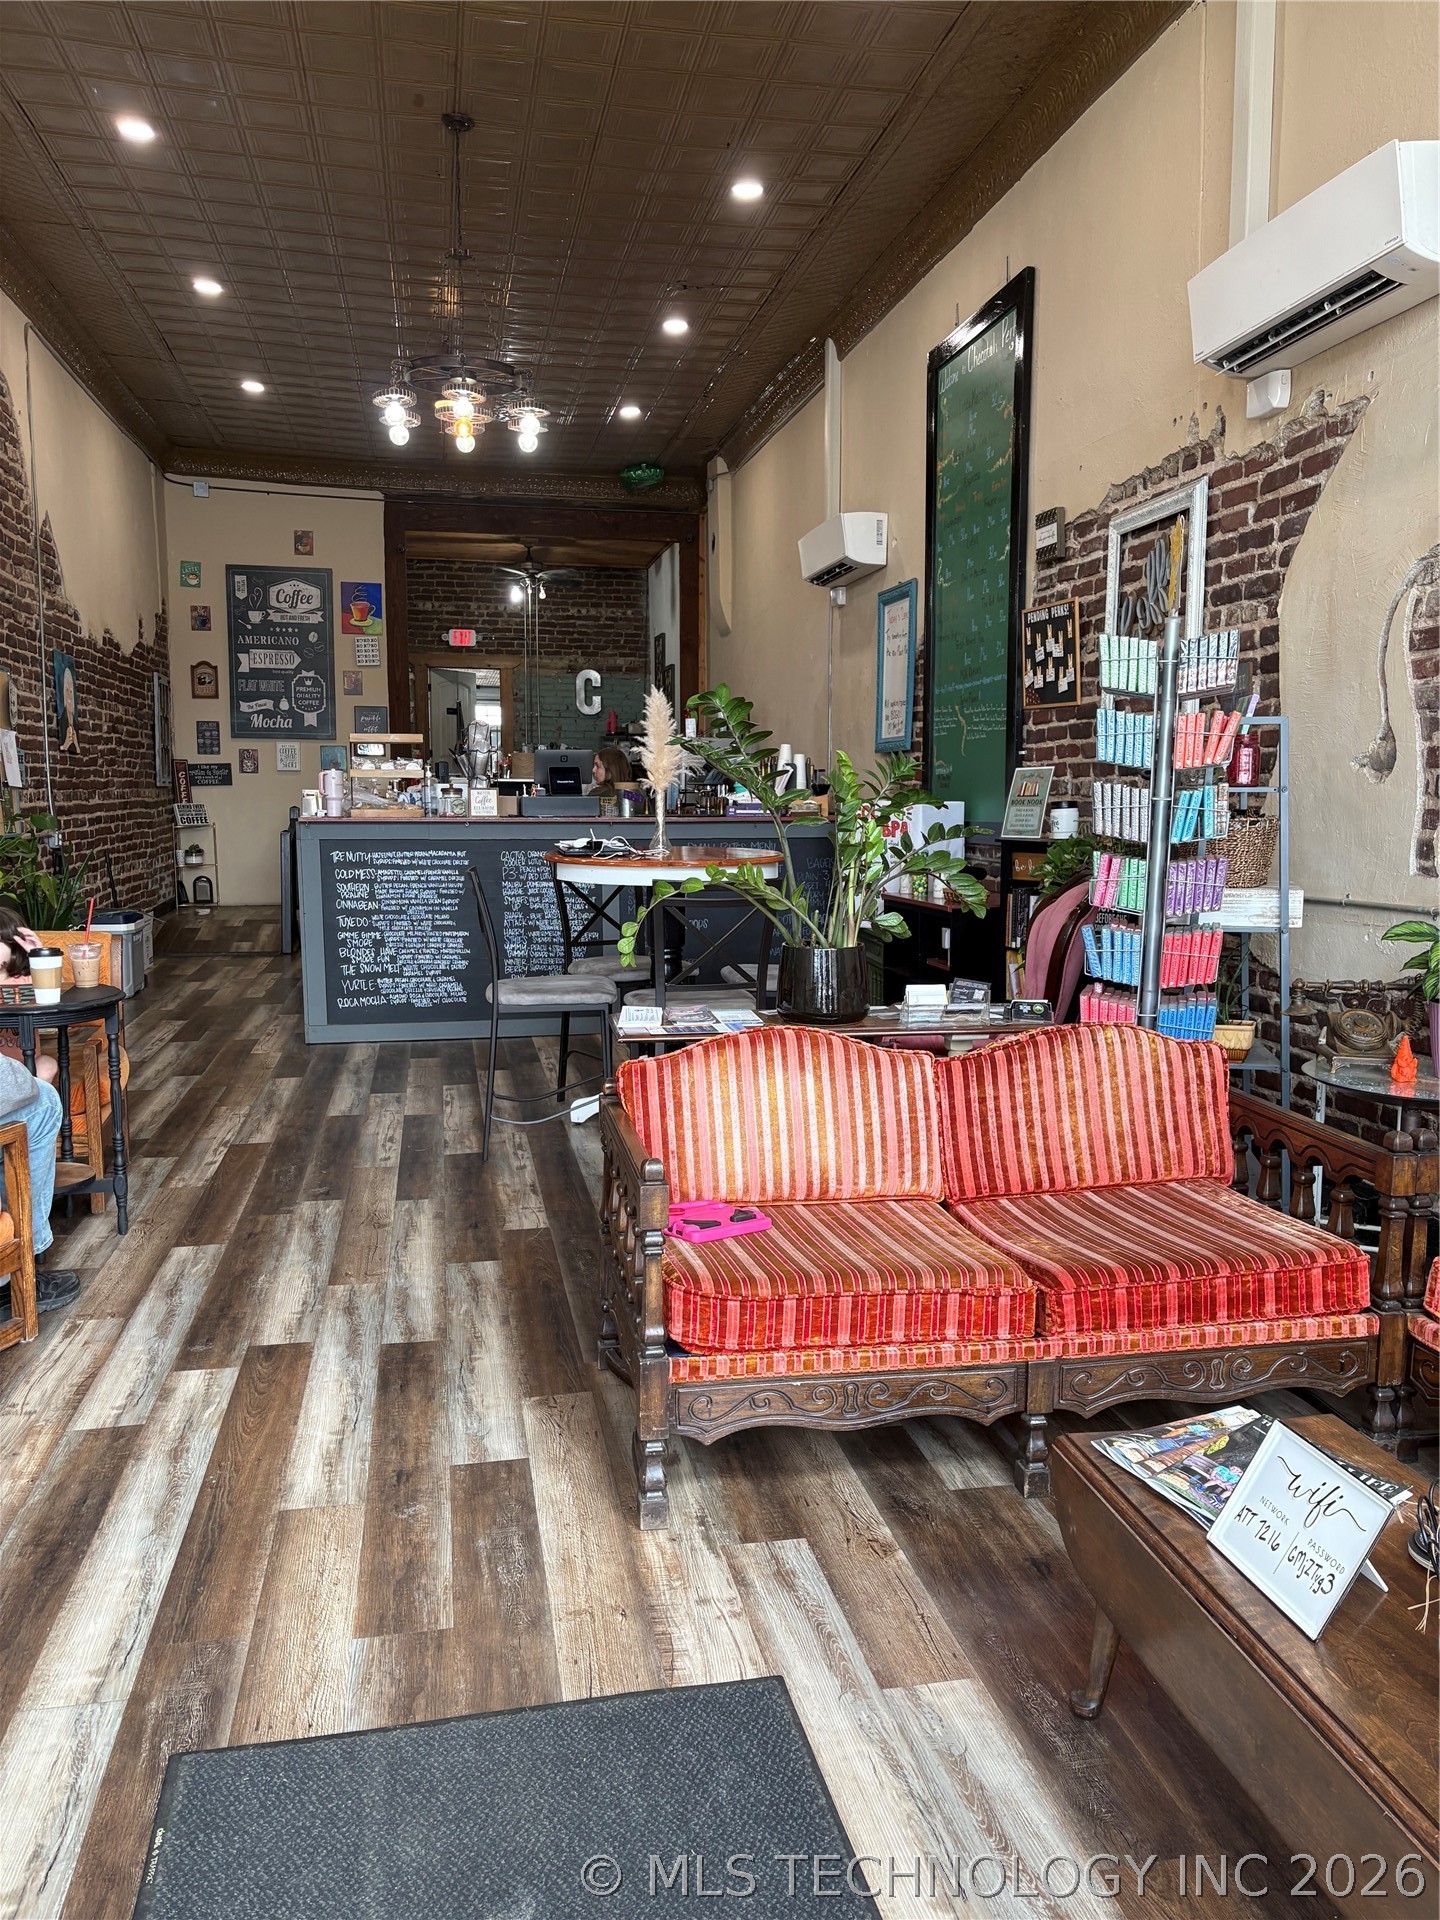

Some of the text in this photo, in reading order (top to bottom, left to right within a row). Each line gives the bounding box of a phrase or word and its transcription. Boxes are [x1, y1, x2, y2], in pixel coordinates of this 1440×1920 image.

[275, 588, 314, 609] Coffee
[1027, 605, 1070, 624] PENDING PERKS!
[237, 635, 300, 646] AMERICANO
[252, 652, 296, 666] ESPRESSO
[237, 679, 285, 692] FLAT WHITE
[575, 669, 602, 715] C
[250, 713, 293, 729] Mocha
[179, 816, 209, 824] COFFEE
[334, 868, 355, 880] COLD
[336, 882, 370, 893] SOUTHERN
[340, 890, 370, 899] PRALINE
[512, 903, 522, 912] UP
[503, 918, 528, 928] ATTACK
[337, 931, 360, 941] GIMME
[346, 938, 373, 948] SMORE
[338, 947, 376, 958] BLONDES
[350, 954, 375, 964] SMORE
[377, 955, 391, 963] FUN
[340, 964, 357, 976] THE
[359, 963, 383, 974] SNOW
[504, 965, 528, 974] BERRY
[336, 997, 360, 1009] ROCA
[1277, 1456, 1366, 1531] wifi
[1259, 1495, 1289, 1526] NETWORK
[1233, 1504, 1280, 1553] ATT 7216
[1307, 1538, 1346, 1575] PASSWORD
